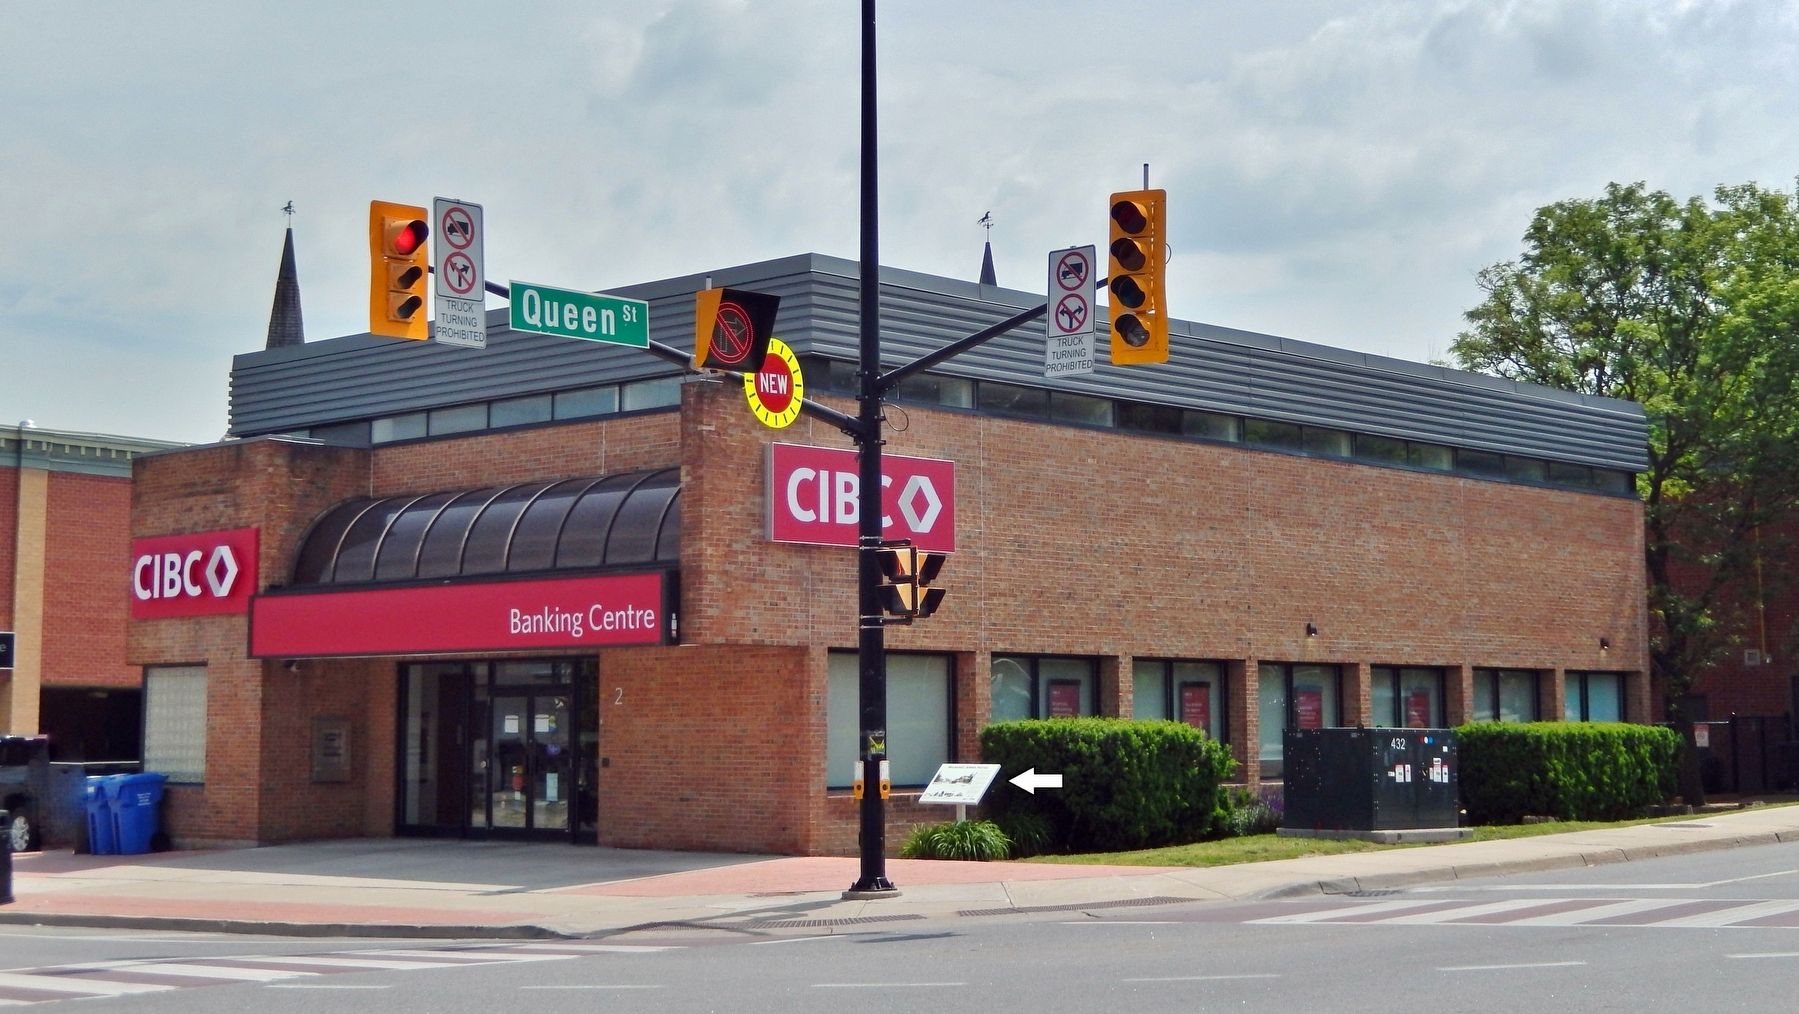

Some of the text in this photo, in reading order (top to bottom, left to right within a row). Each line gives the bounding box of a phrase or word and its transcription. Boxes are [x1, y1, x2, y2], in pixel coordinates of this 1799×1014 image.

[446, 299, 474, 313] TRUCK
[522, 288, 637, 336] Queen St
[441, 312, 478, 328] TURNING
[436, 325, 485, 342] PROHIBITED
[1057, 335, 1084, 348] TRUCK
[1051, 347, 1087, 360] TURNING
[1046, 359, 1093, 372] PROHIBITED
[760, 372, 788, 395] NEW
[134, 550, 203, 601] CIBC
[509, 603, 656, 638] Banking Centre
[614, 687, 623, 705] 2
[1390, 737, 1406, 750] 432
